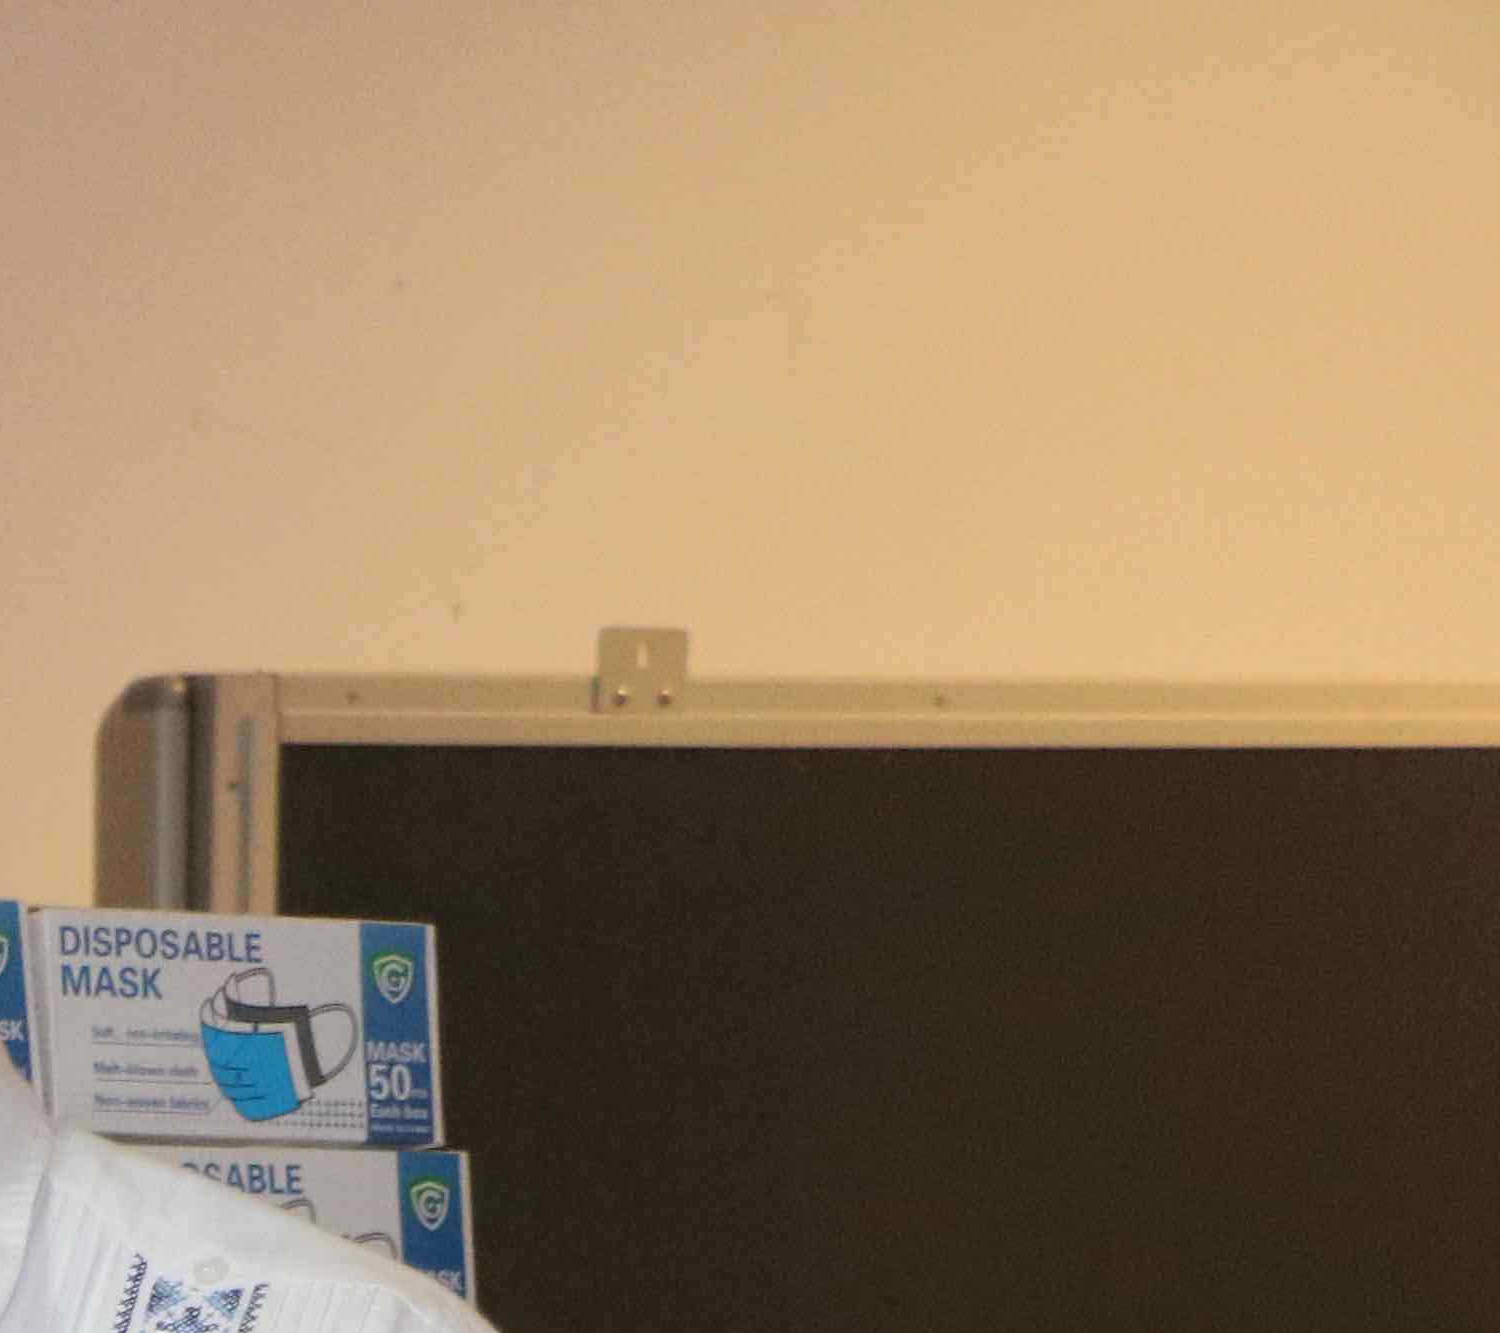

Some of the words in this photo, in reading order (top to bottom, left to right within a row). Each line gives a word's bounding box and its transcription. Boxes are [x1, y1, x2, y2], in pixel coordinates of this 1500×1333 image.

[60, 923, 262, 965] DISPOSABLE
[62, 963, 162, 1000] MASK
[368, 1040, 426, 1064] MASK
[369, 1063, 411, 1101] 50
